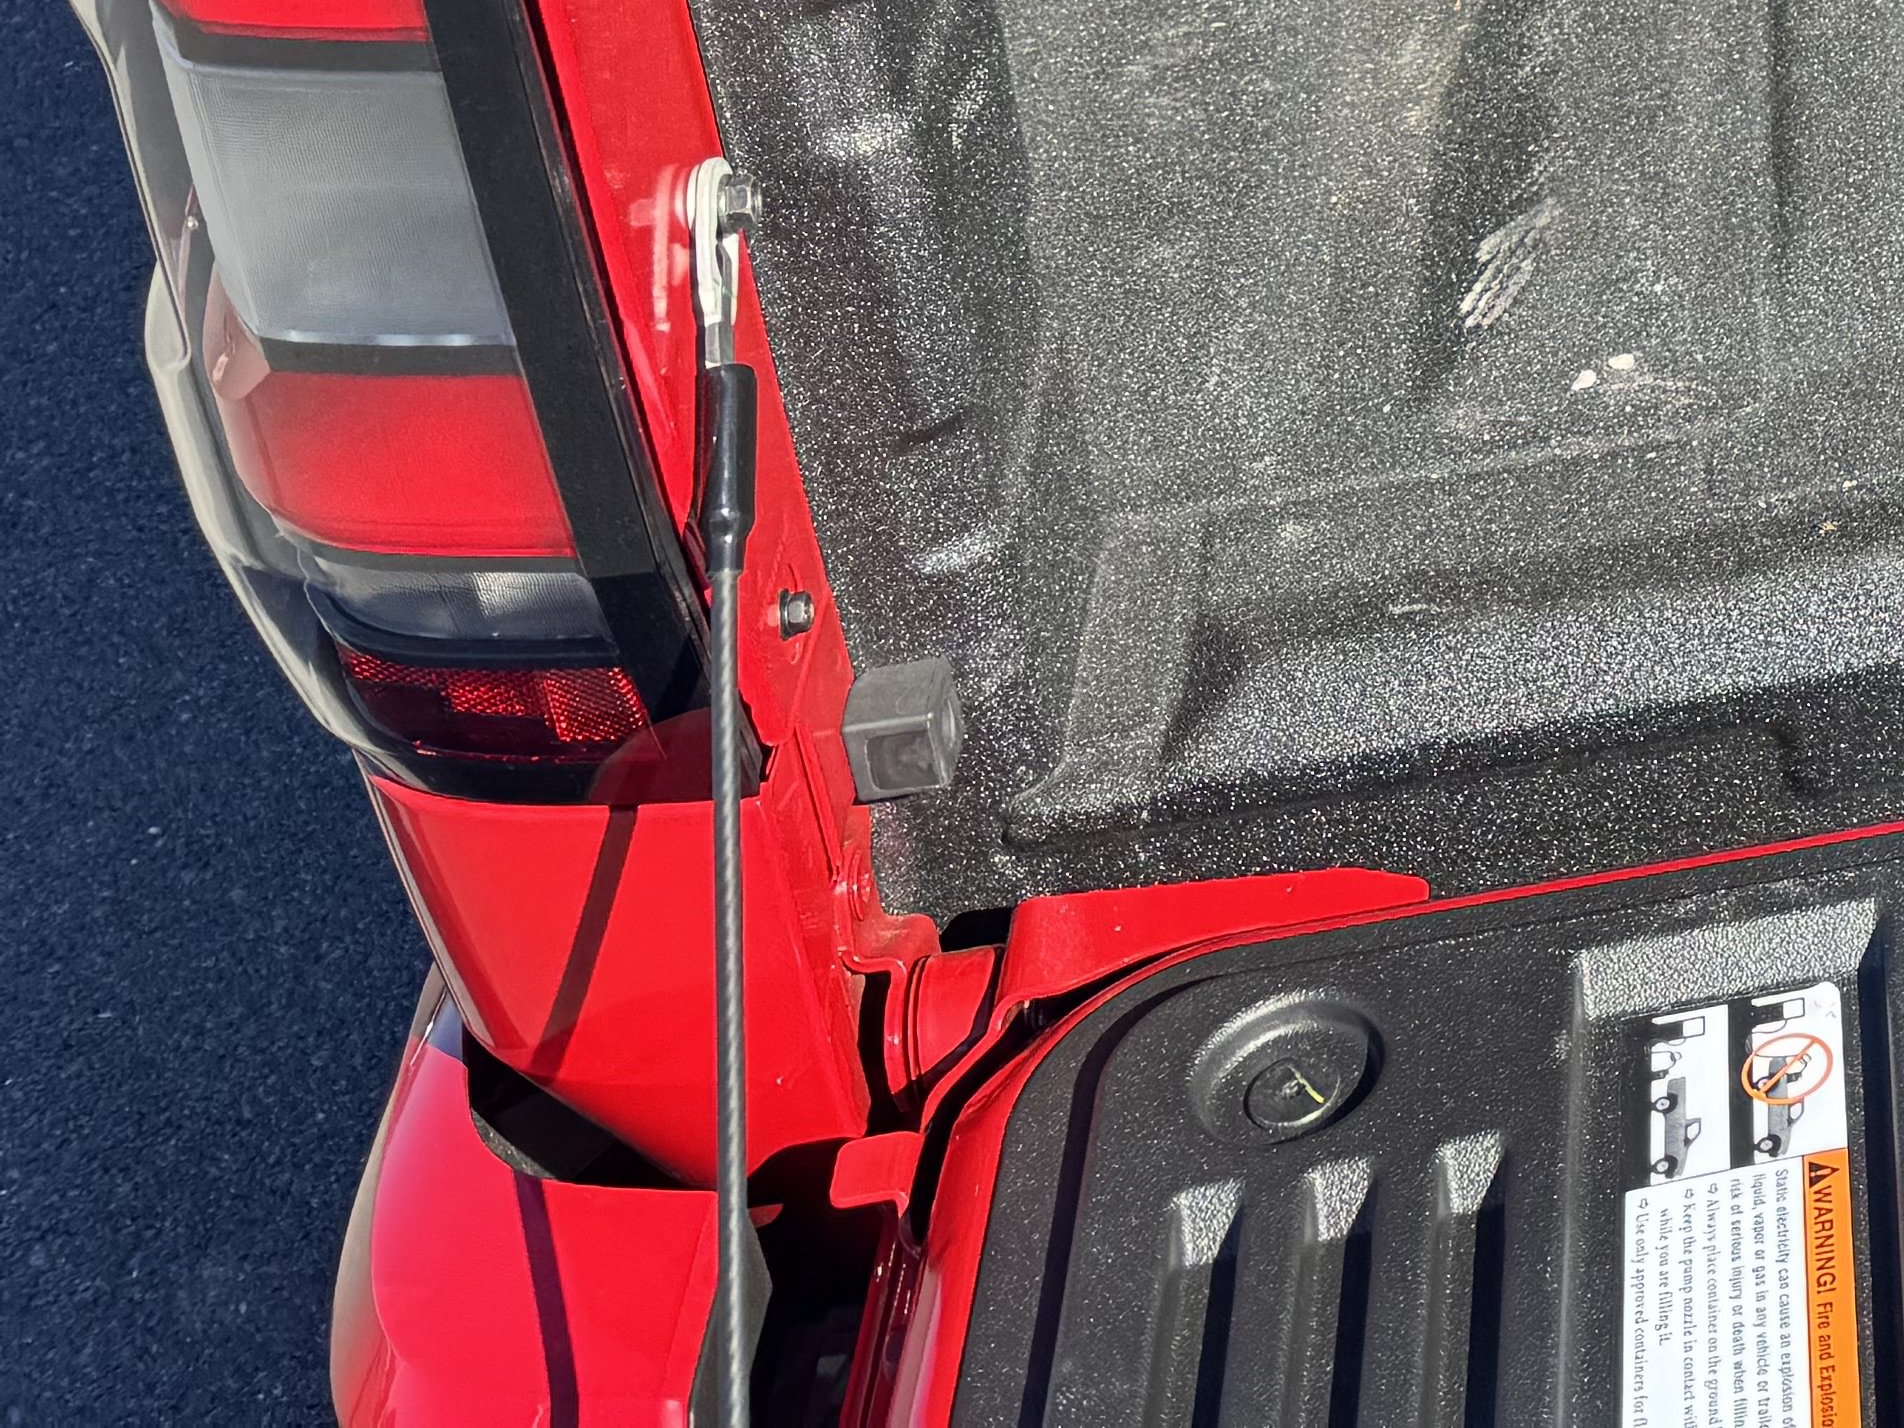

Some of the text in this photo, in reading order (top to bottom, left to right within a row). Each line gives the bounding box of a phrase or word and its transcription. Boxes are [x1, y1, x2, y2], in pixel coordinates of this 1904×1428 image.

[1730, 1179, 1743, 1200] risk
[1750, 1174, 1767, 1210] liquid,
[1776, 1169, 1789, 1202] Static
[1636, 1213, 1649, 1234] Use
[1659, 1208, 1673, 1240] while
[1679, 1203, 1696, 1232] Keep
[1731, 1204, 1743, 1215] of
[1731, 1220, 1743, 1262] serious
[1751, 1212, 1765, 1244] vapor
[1775, 1207, 1792, 1263] electricity
[1814, 1185, 1836, 1294] WARNING!
[1631, 1239, 1649, 1264] only
[1655, 1245, 1669, 1266] you
[1683, 1236, 1696, 1255] the
[1755, 1249, 1765, 1260] or
[1659, 1271, 1669, 1288] are
[1678, 1259, 1693, 1293] pump
[1729, 1266, 1744, 1300] injury
[1752, 1266, 1766, 1286] gas
[1779, 1268, 1789, 1289] can
[1630, 1268, 1649, 1324] approved
[1732, 1305, 1743, 1316] or
[1756, 1291, 1768, 1302] in
[1779, 1294, 1791, 1328] cause
[1655, 1292, 1673, 1331] filling
[1684, 1298, 1697, 1336] nozzle
[1702, 1200, 1723, 1425] Always place container on the ground
[1753, 1307, 1767, 1327] any
[1817, 1302, 1833, 1329] Fire
[1684, 1339, 1697, 1353] in
[1732, 1322, 1745, 1356] death
[1756, 1332, 1770, 1375] vehicle
[1780, 1333, 1791, 1348] an
[1818, 1335, 1835, 1360] and
[1634, 1328, 1648, 1391] containers
[1684, 1357, 1696, 1401] contact
[1733, 1360, 1747, 1394] when
[1757, 1381, 1768, 1392] or
[1778, 1353, 1795, 1412] explosion
[1633, 1396, 1648, 1413] for
